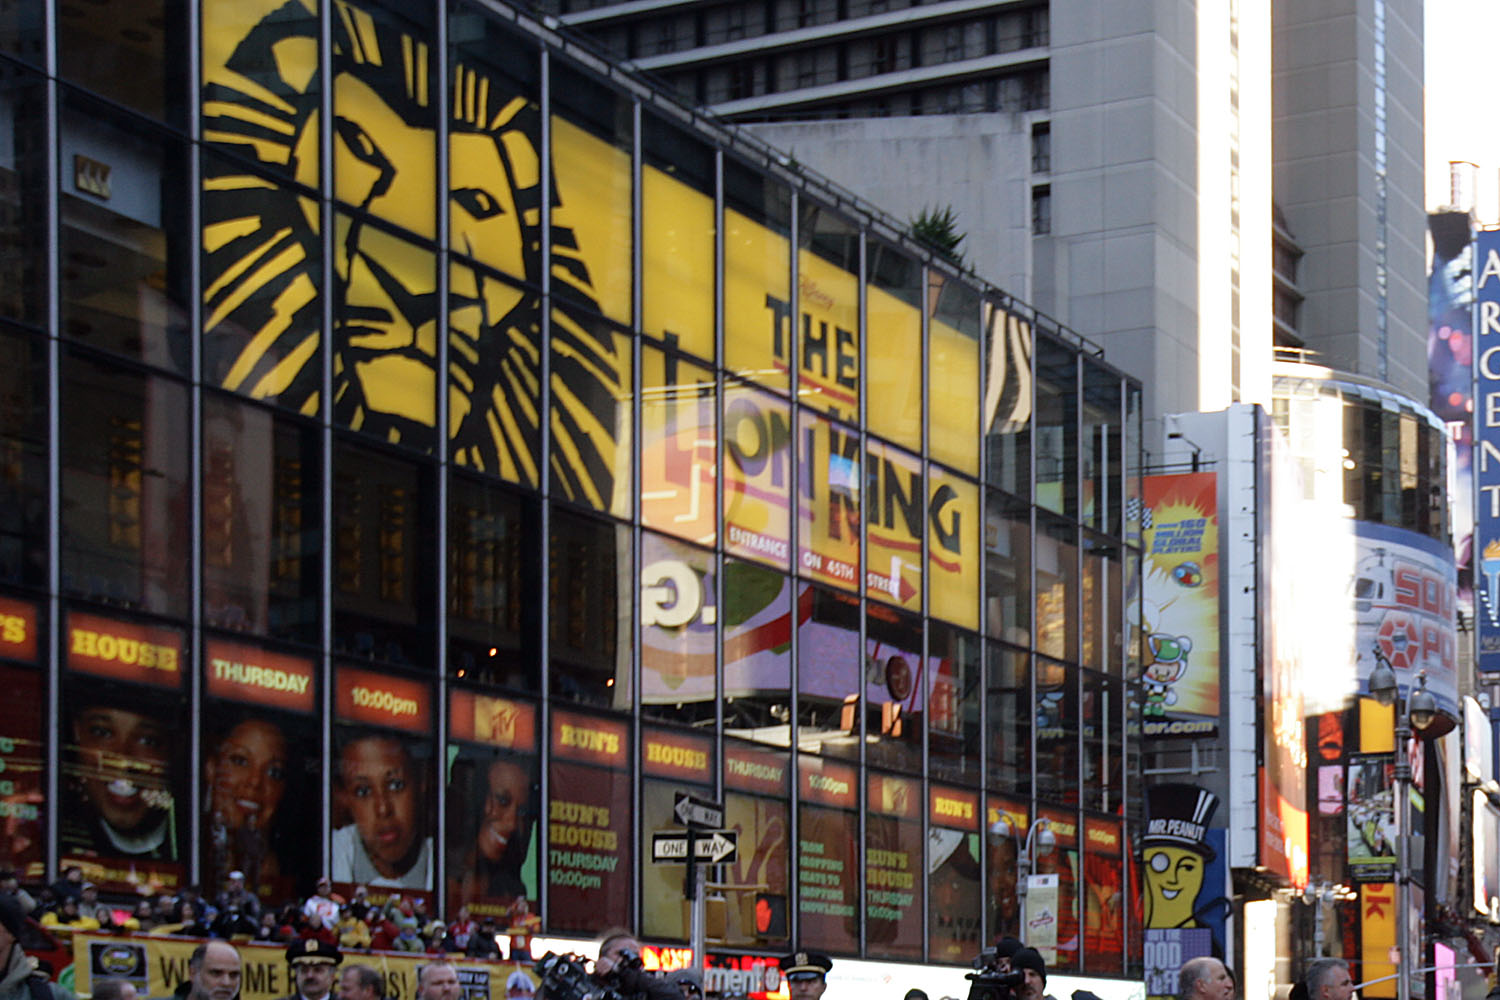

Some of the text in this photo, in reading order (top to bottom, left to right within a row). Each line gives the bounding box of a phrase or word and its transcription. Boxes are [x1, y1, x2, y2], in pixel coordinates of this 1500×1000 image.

[766, 293, 858, 389] THE
[828, 405, 962, 557] KING
[728, 526, 789, 560] ENTRANCE
[803, 552, 823, 570] ON
[827, 560, 855, 582] 45TH
[72, 626, 178, 671] HOUSE
[212, 658, 310, 695] THURSDAY
[351, 686, 418, 716] 10:00pm
[560, 723, 619, 755] RUN'S
[647, 741, 707, 771] HOUSE
[549, 800, 611, 825] RUN'S
[549, 825, 618, 851] HOUSE
[662, 840, 726, 855] ONE WAY
[549, 850, 618, 874] THURSDAY
